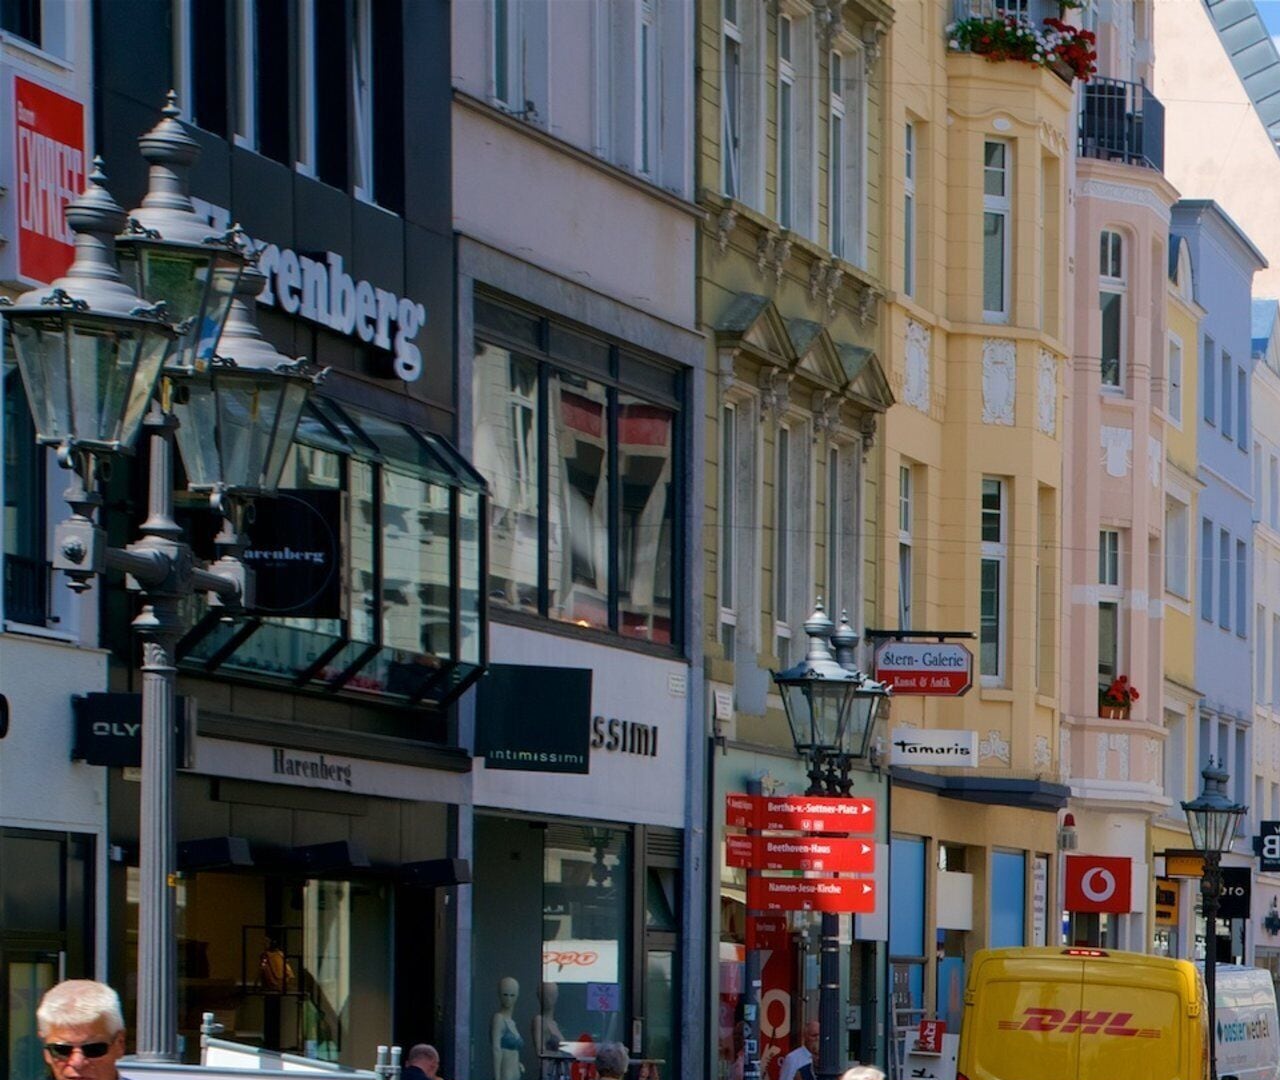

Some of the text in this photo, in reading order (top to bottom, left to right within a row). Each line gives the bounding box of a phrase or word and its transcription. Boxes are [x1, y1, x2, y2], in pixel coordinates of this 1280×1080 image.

[922, 651, 964, 669] Galerie
[893, 675, 917, 689] Kunst
[929, 676, 951, 689] Antik
[271, 746, 354, 787] Harenberg
[766, 842, 832, 855] Beethoven-Haus
[1017, 1007, 1148, 1038] DHL
